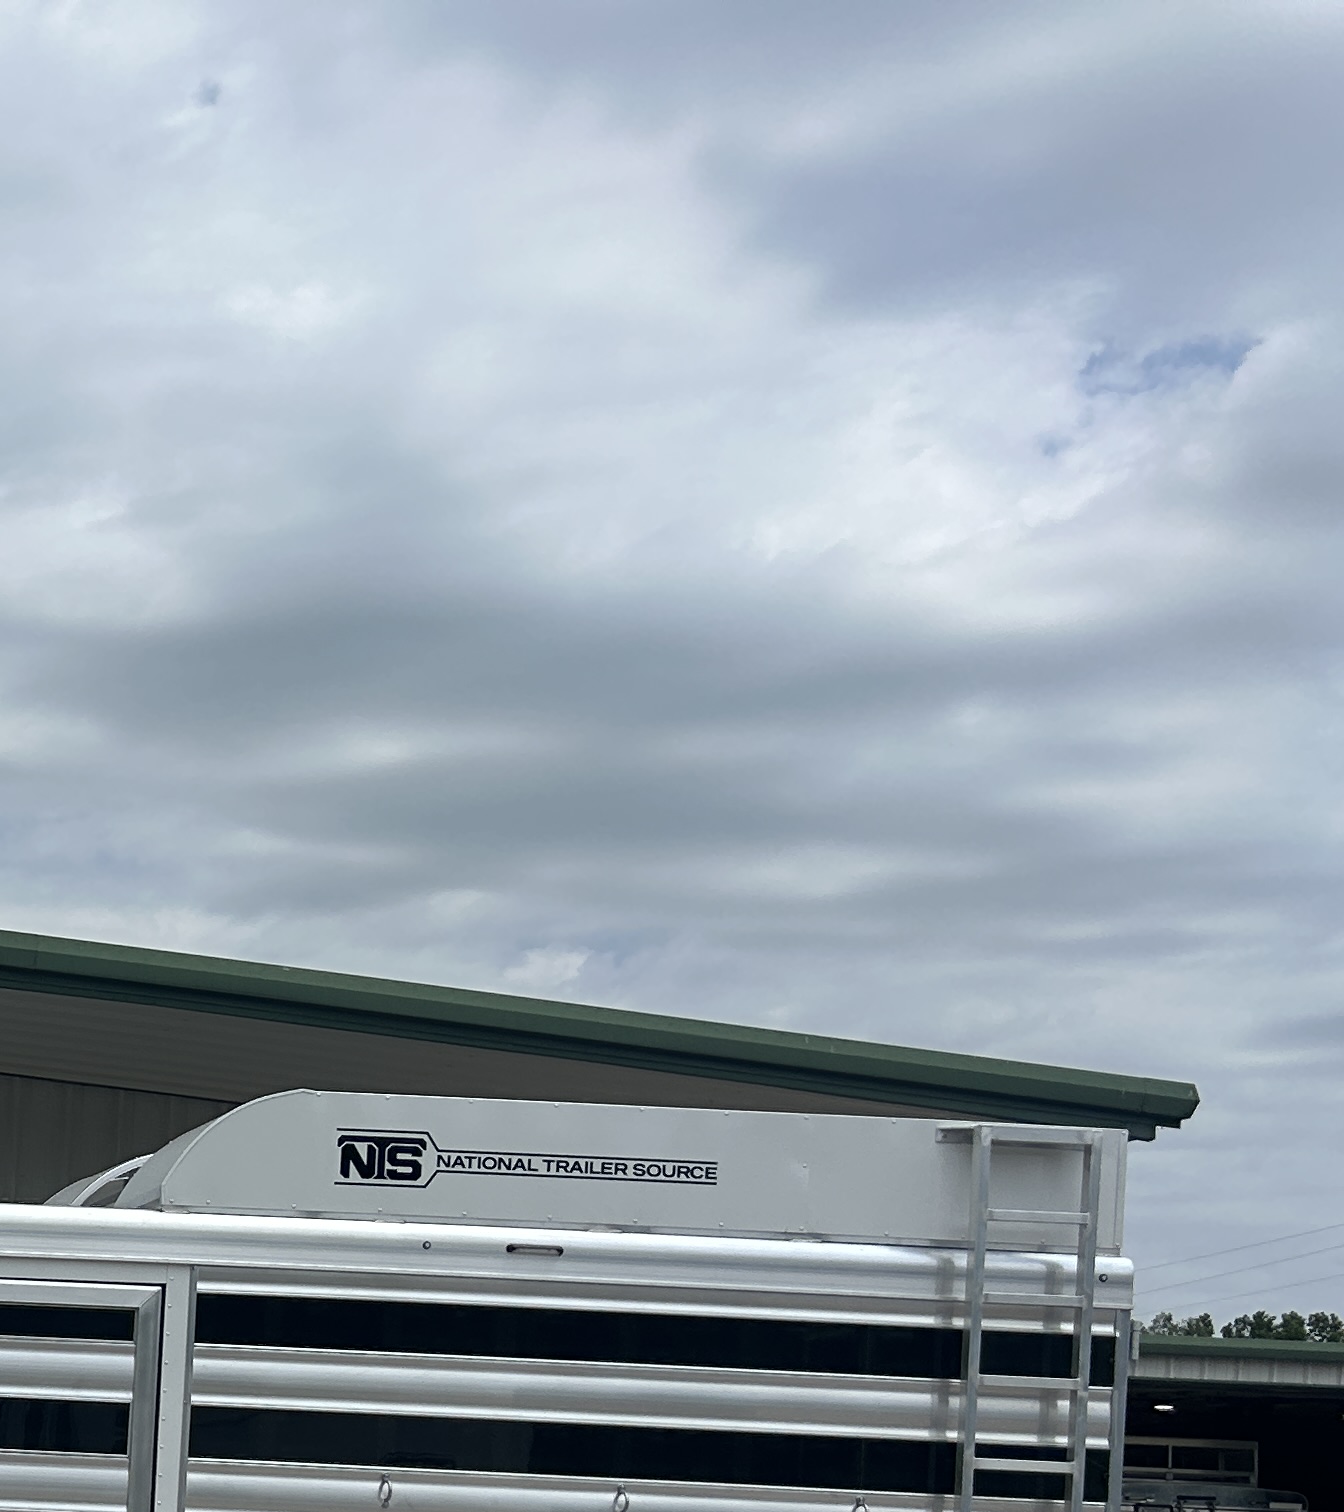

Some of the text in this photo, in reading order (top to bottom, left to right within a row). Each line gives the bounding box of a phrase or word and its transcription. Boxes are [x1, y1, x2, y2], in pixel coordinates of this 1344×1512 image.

[337, 1134, 718, 1182] NTS NATIONAL TRAILER SOURCE
